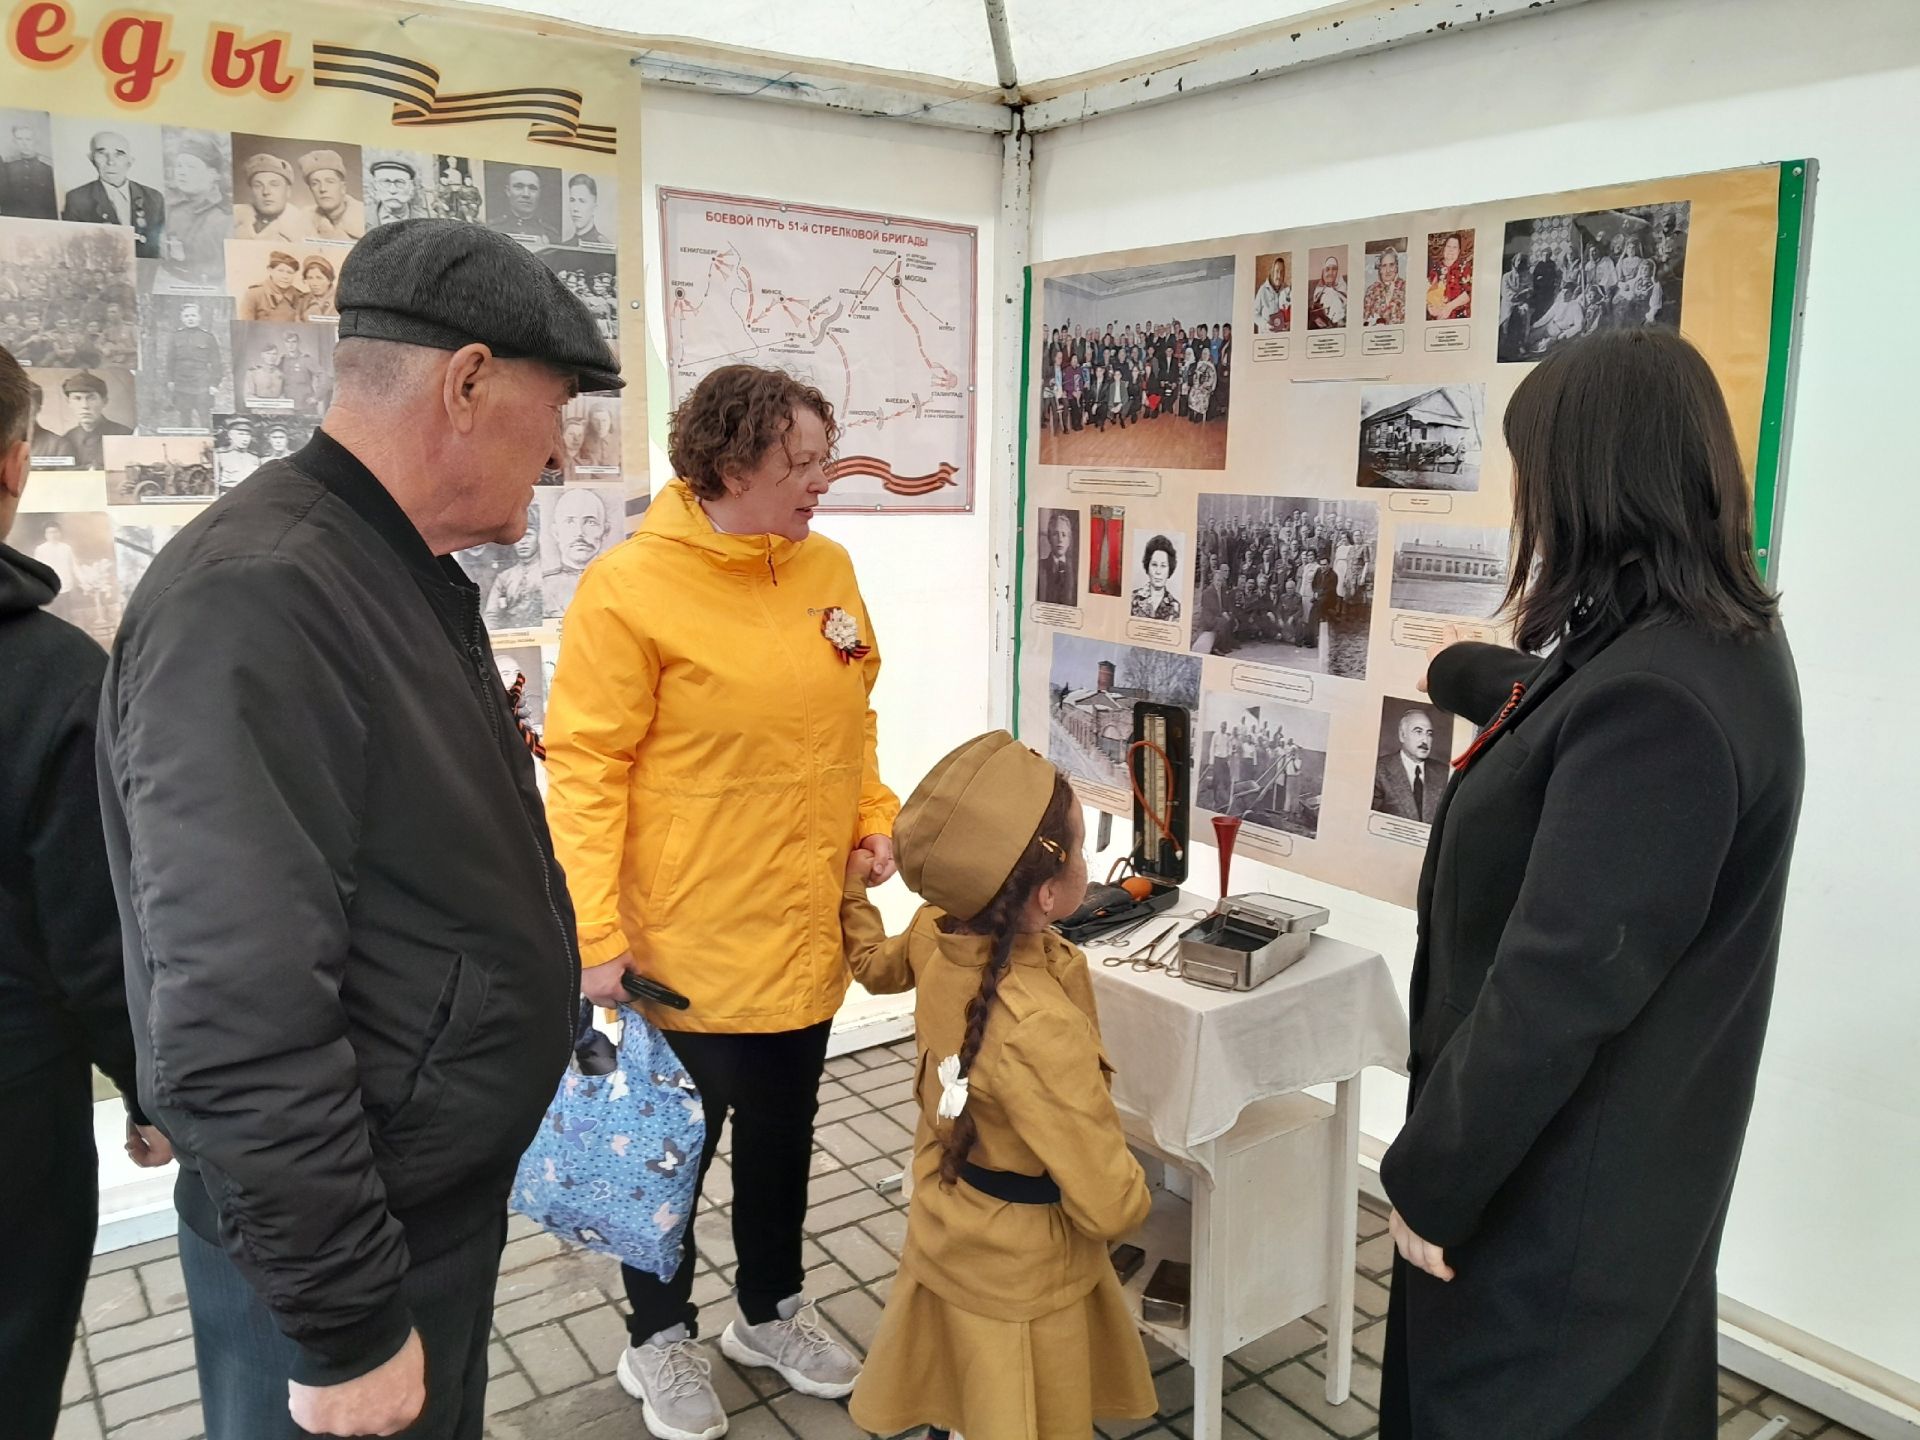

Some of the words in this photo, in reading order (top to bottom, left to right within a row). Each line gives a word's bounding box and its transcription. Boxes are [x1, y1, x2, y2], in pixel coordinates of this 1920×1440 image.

[705, 211, 754, 226] БОЕВОЙ
[756, 216, 785, 230] ПУТЬ
[788, 221, 809, 233] 51-й
[811, 223, 879, 241] СТРЕЛКОВОЙ
[881, 232, 929, 247] БРИГАДЫ
